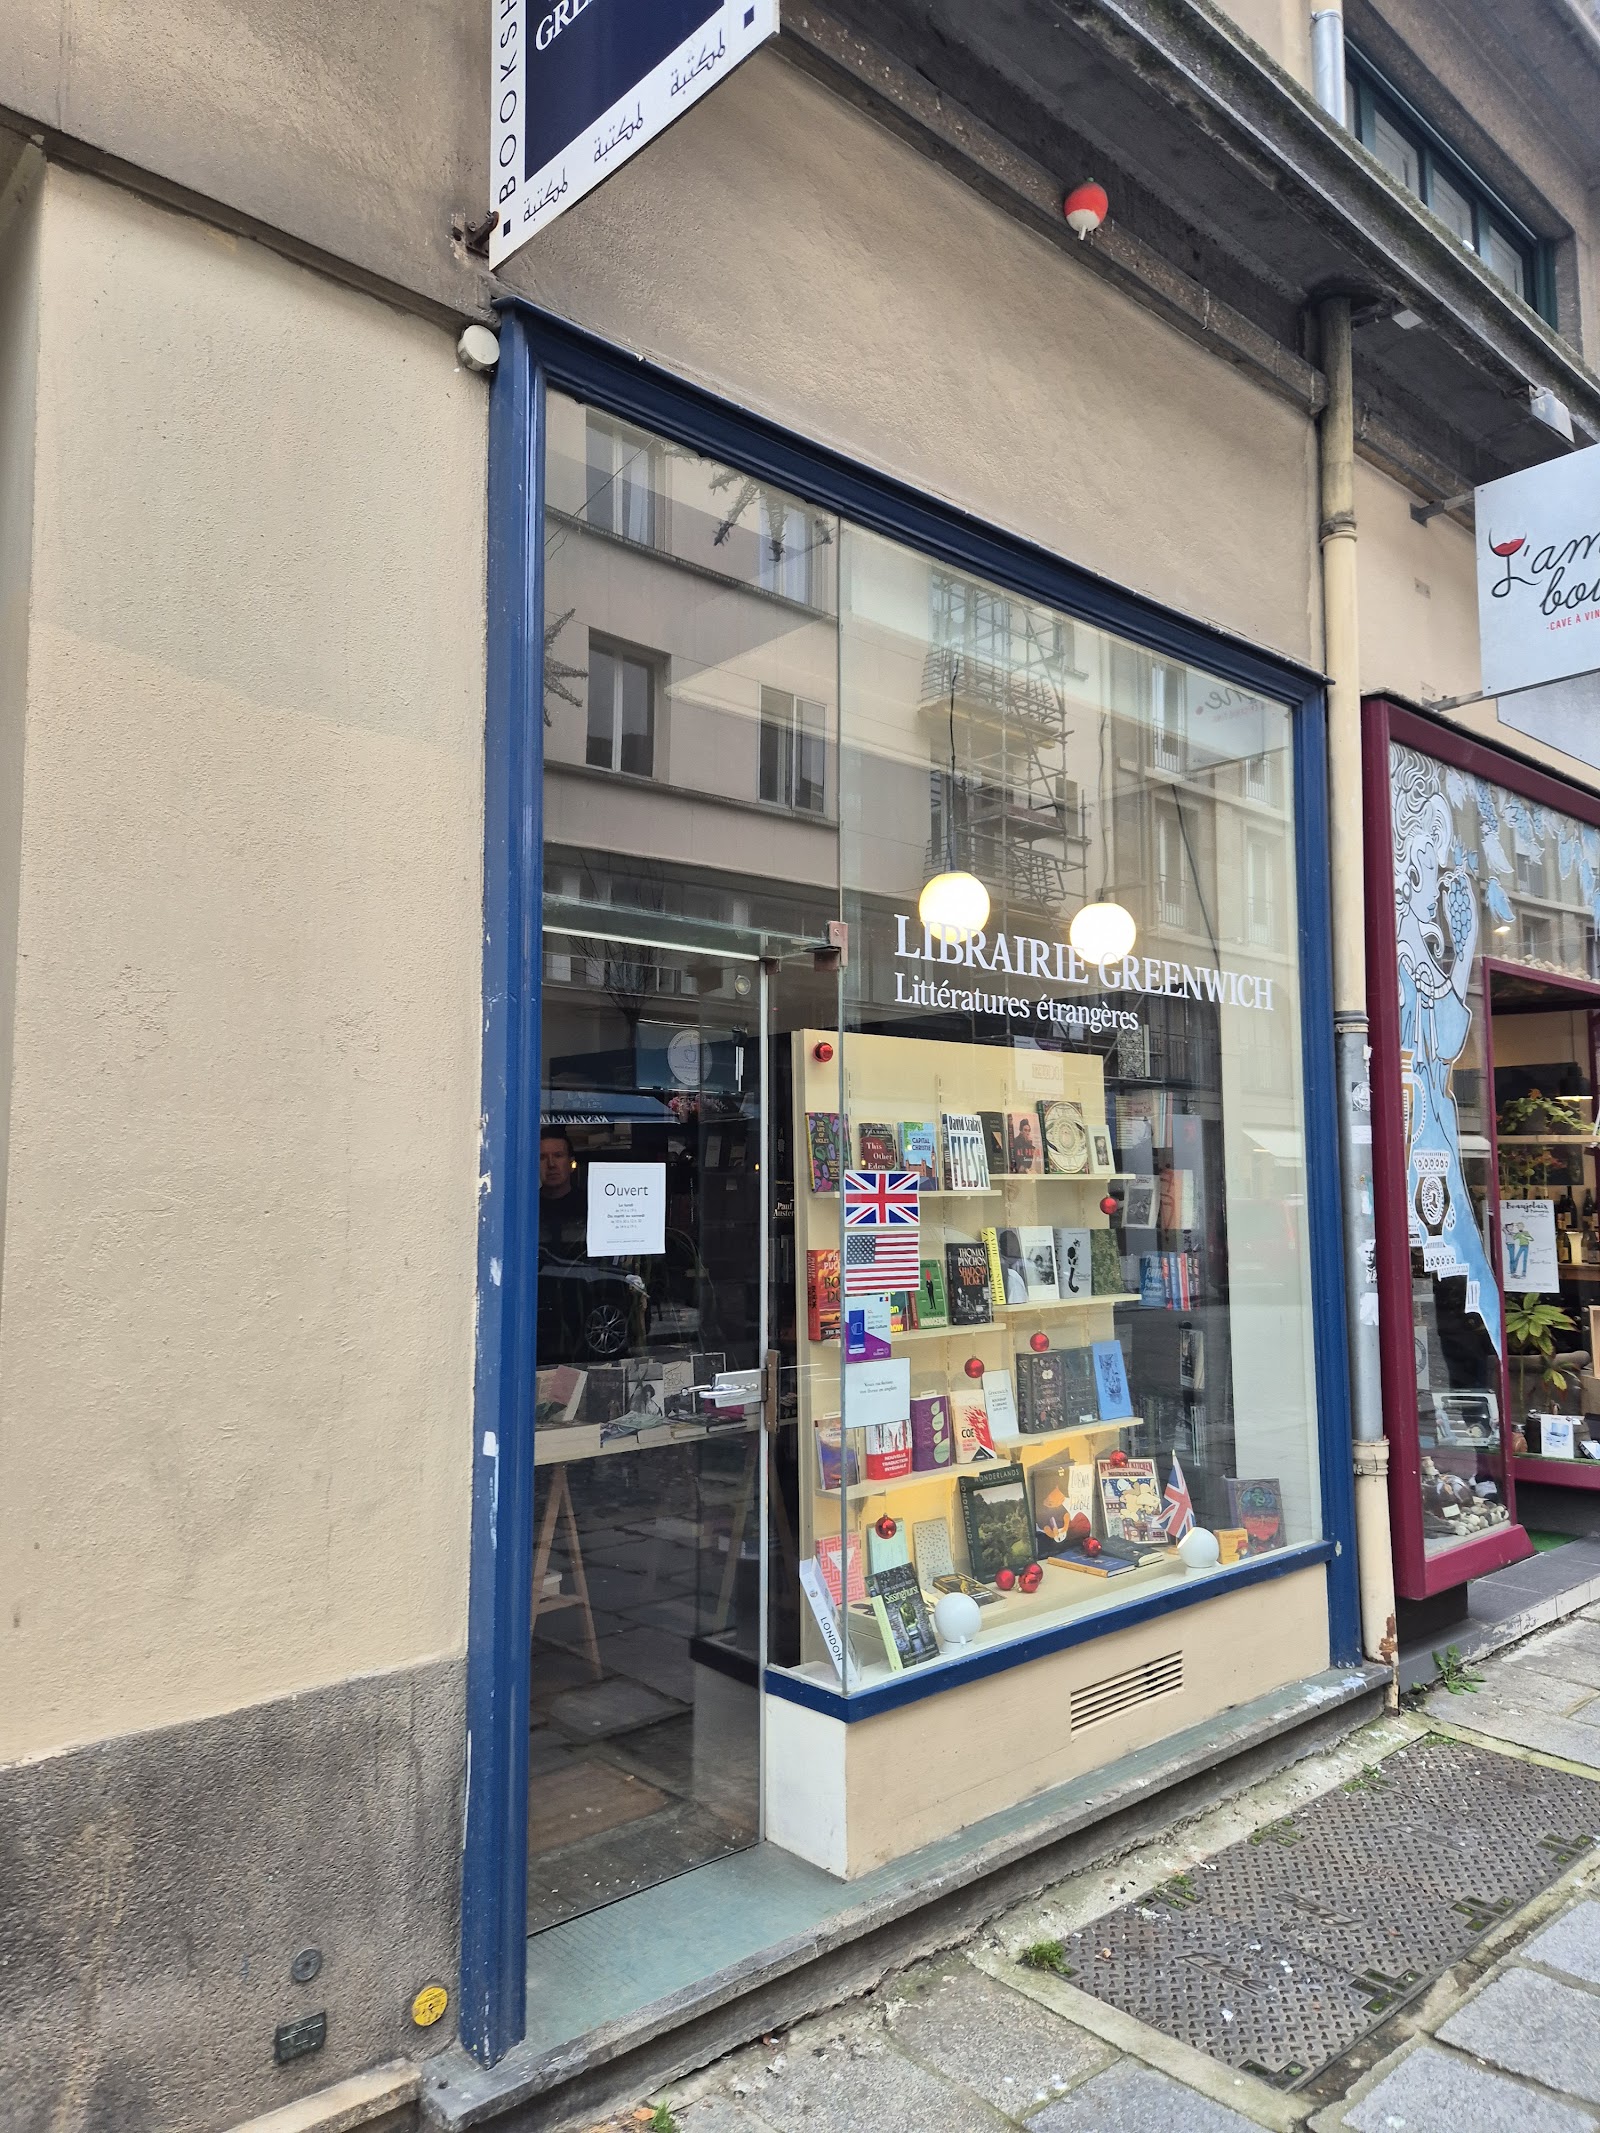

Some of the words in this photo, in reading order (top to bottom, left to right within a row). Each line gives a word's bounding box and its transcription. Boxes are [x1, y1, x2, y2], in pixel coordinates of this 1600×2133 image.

[1488, 529, 1600, 598] L'am
[894, 913, 1089, 984] LIBRAIRIE
[1098, 951, 1275, 1011] GREENWICH
[894, 971, 1031, 1019] Littératures
[1036, 994, 1139, 1034] étrangères
[948, 1115, 965, 1131] David
[965, 1116, 982, 1133] Szalay
[866, 1142, 883, 1150] This
[873, 1153, 893, 1161] Other
[867, 1162, 887, 1170] Eden
[604, 1183, 649, 1196] Ouvert
[777, 1202, 793, 1211] Paul
[958, 1248, 985, 1257] THOMAS
[958, 1257, 987, 1266] PYNCHON
[959, 1266, 987, 1276] SHADOW
[962, 1275, 985, 1286] TICKET
[961, 1428, 975, 1438] COE
[882, 1458, 908, 1466] TRADUCTION
[974, 1468, 1020, 1483] WONDERLANDS
[959, 1479, 974, 1545] WONDERLANDS
[884, 1586, 920, 1603] Sissinghurst
[820, 1616, 843, 1661] LONDON
